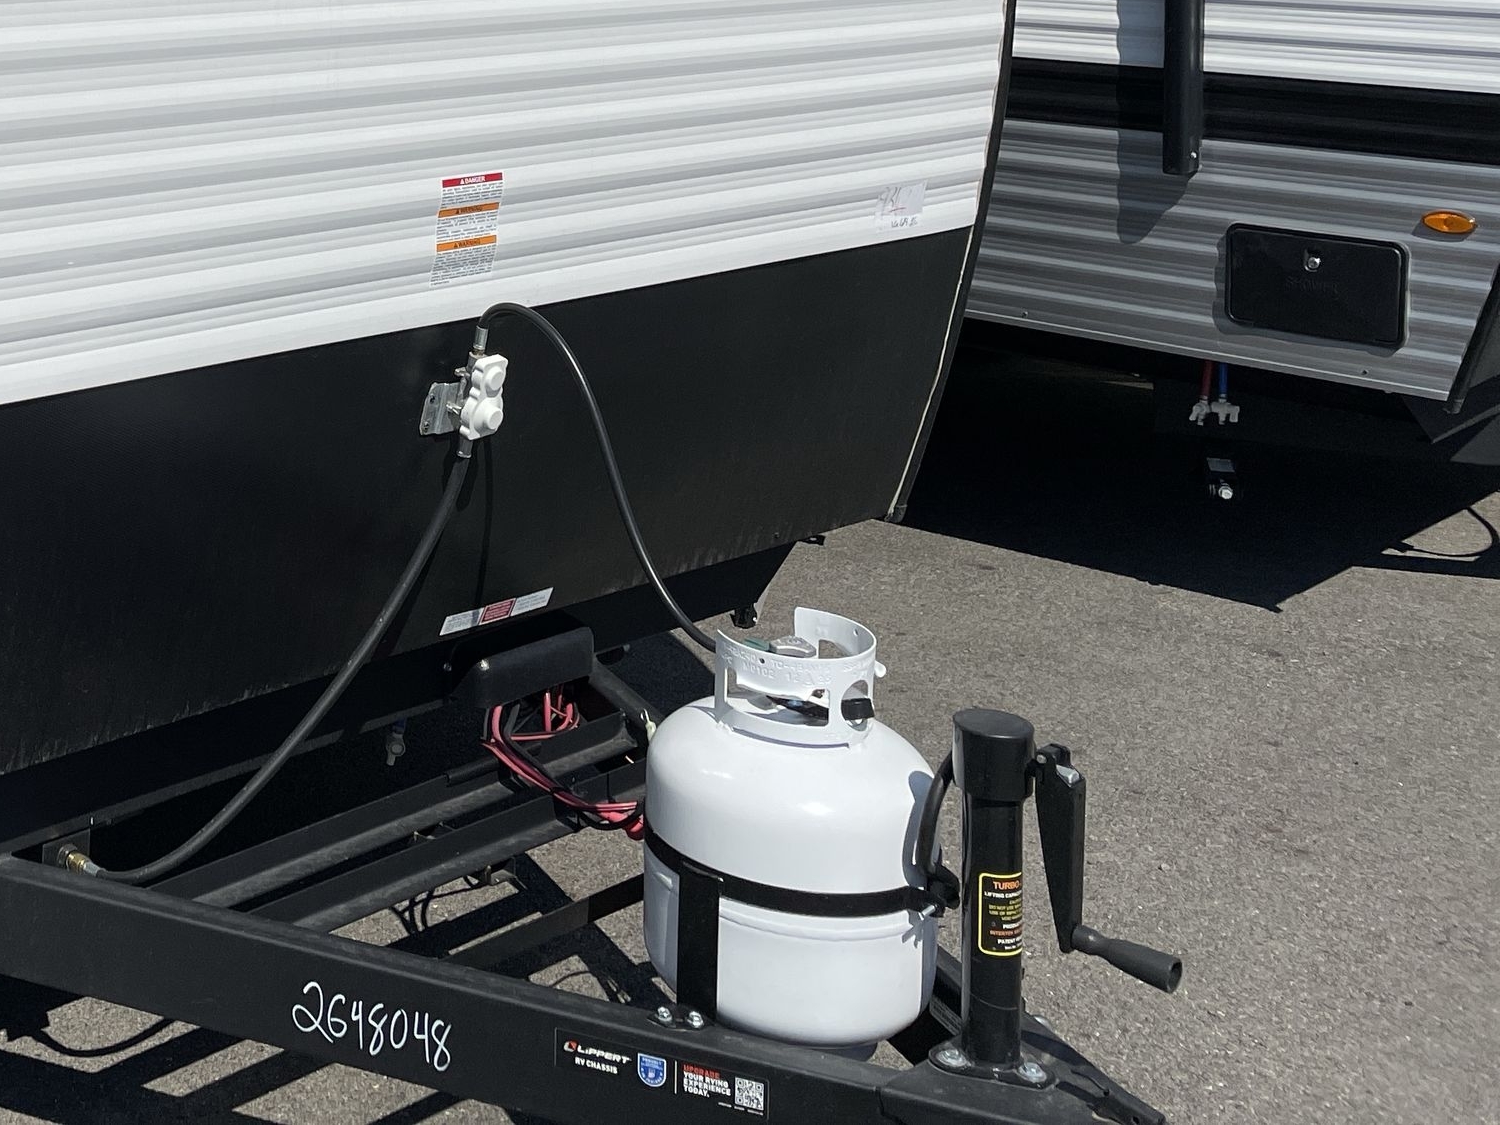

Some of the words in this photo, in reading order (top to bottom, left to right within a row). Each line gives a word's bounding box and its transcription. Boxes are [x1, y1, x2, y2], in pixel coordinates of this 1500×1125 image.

[292, 981, 452, 1072] 2648048
[575, 1057, 585, 1066] RV
[586, 1060, 618, 1074] CHASSIS
[683, 1064, 720, 1079] UPGRADE
[683, 1071, 704, 1081] YOUR
[705, 1076, 729, 1088] RVING
[683, 1078, 731, 1096] EXPERIENCE
[683, 1084, 710, 1098] TODAY.
